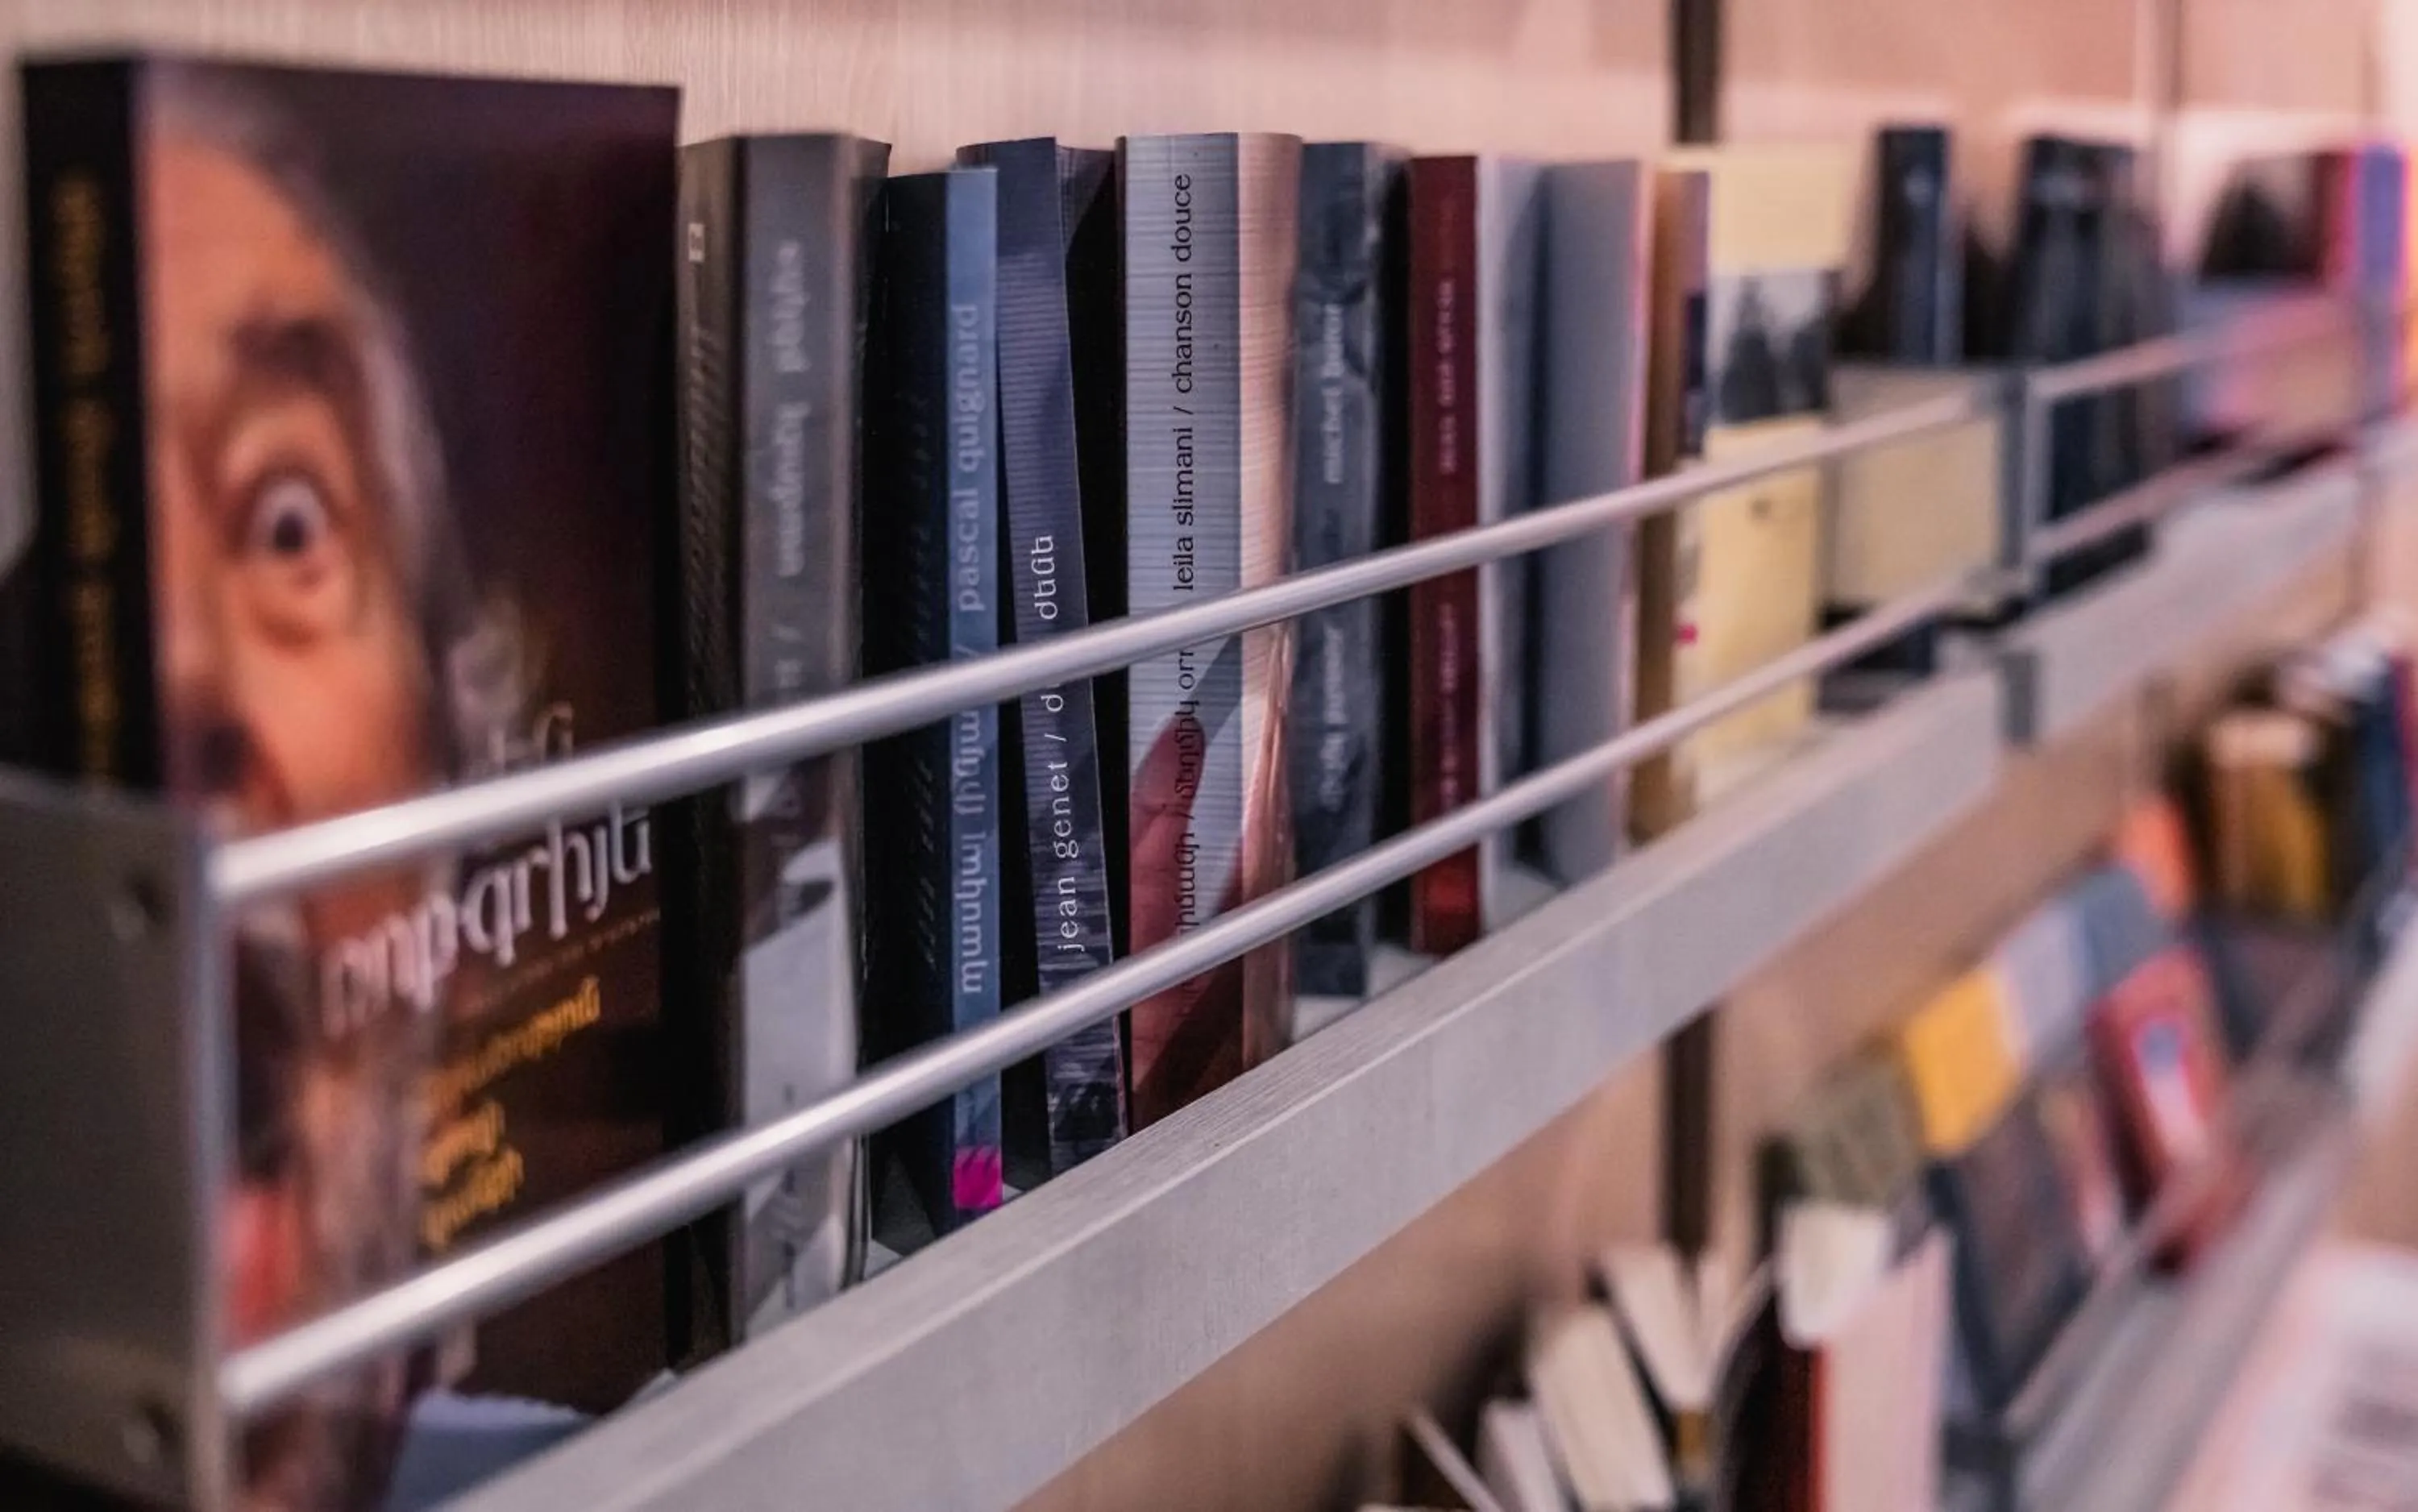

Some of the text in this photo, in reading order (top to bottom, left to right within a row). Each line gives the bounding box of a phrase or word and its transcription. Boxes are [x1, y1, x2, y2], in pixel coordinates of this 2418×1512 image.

[1170, 174, 1192, 262] douce
[1170, 273, 1193, 394] chanson
[953, 305, 983, 612] pascal quignard
[1171, 427, 1194, 525] slimani
[1171, 537, 1194, 591] leila
[1049, 762, 1078, 861] genet
[1055, 876, 1085, 953] jean
